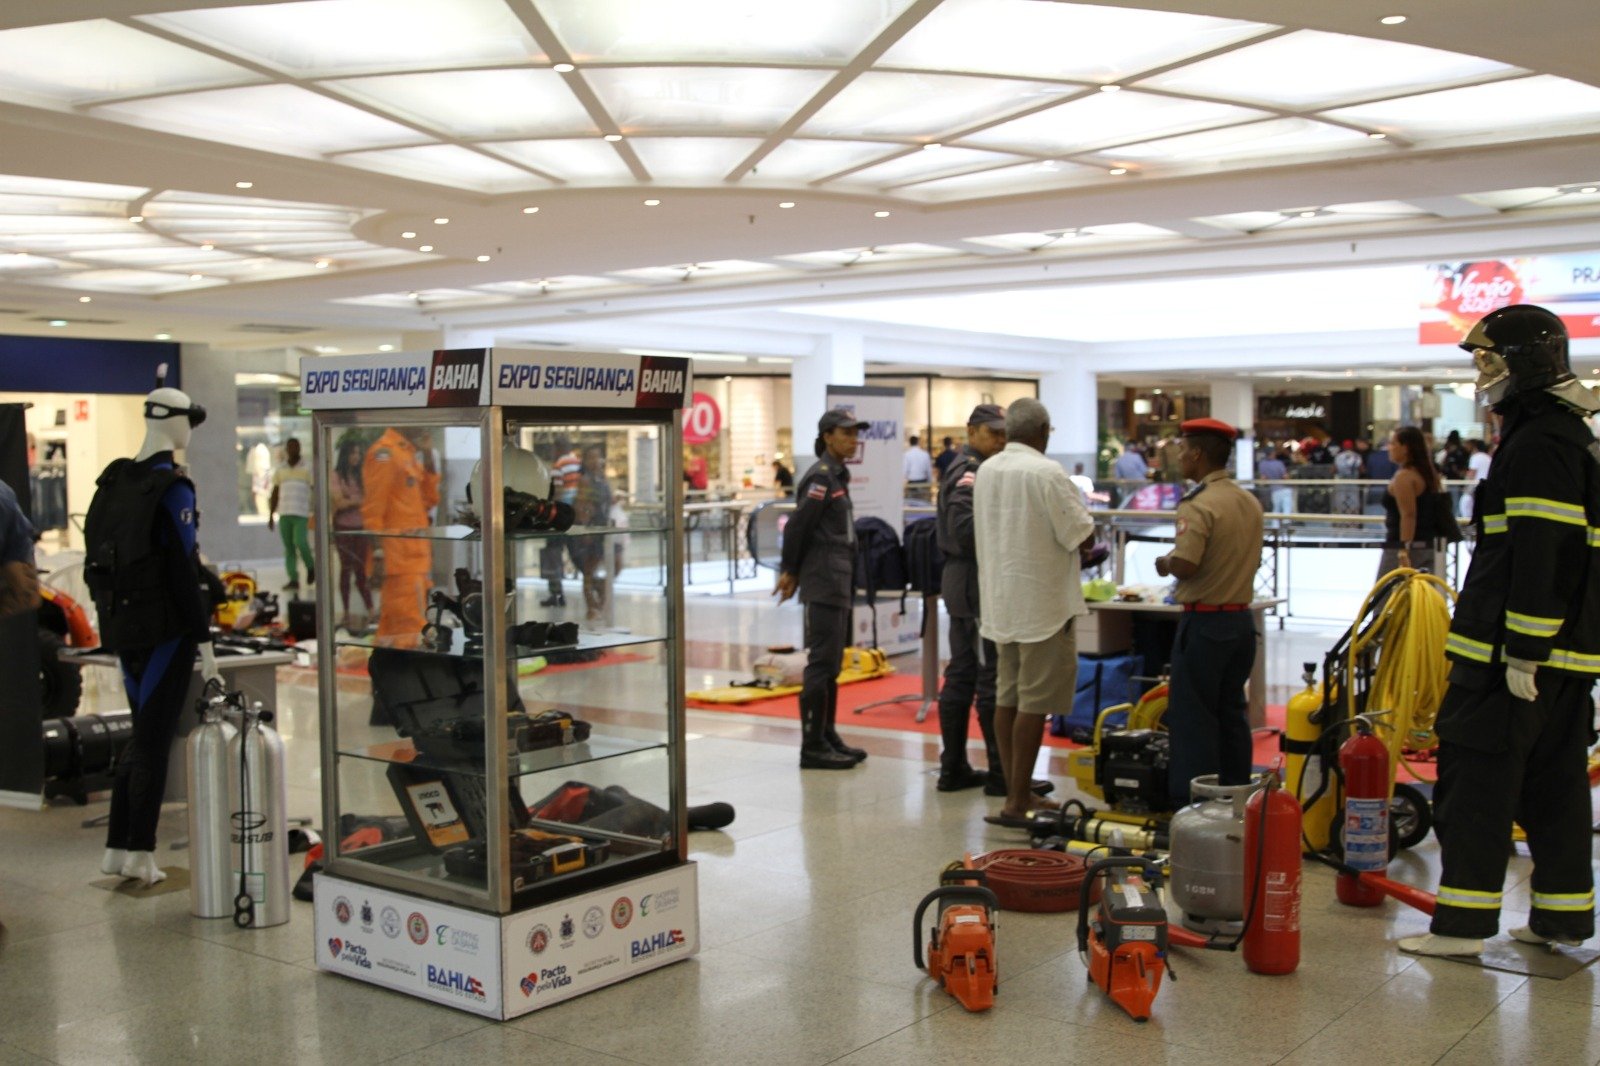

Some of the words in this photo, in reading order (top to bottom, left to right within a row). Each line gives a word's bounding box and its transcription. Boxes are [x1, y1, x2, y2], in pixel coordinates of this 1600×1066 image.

[305, 370, 340, 394] EXPO
[341, 365, 426, 396] SEGURANÇA
[432, 364, 480, 390] BAHIA
[498, 364, 540, 389] EXPO
[543, 365, 635, 397] SEGURANÇA
[640, 369, 684, 394] BAHIA
[344, 940, 367, 956] Pacto
[631, 930, 677, 958] BAHIA
[427, 964, 476, 994] BAHIA
[541, 965, 567, 980] Pacto
